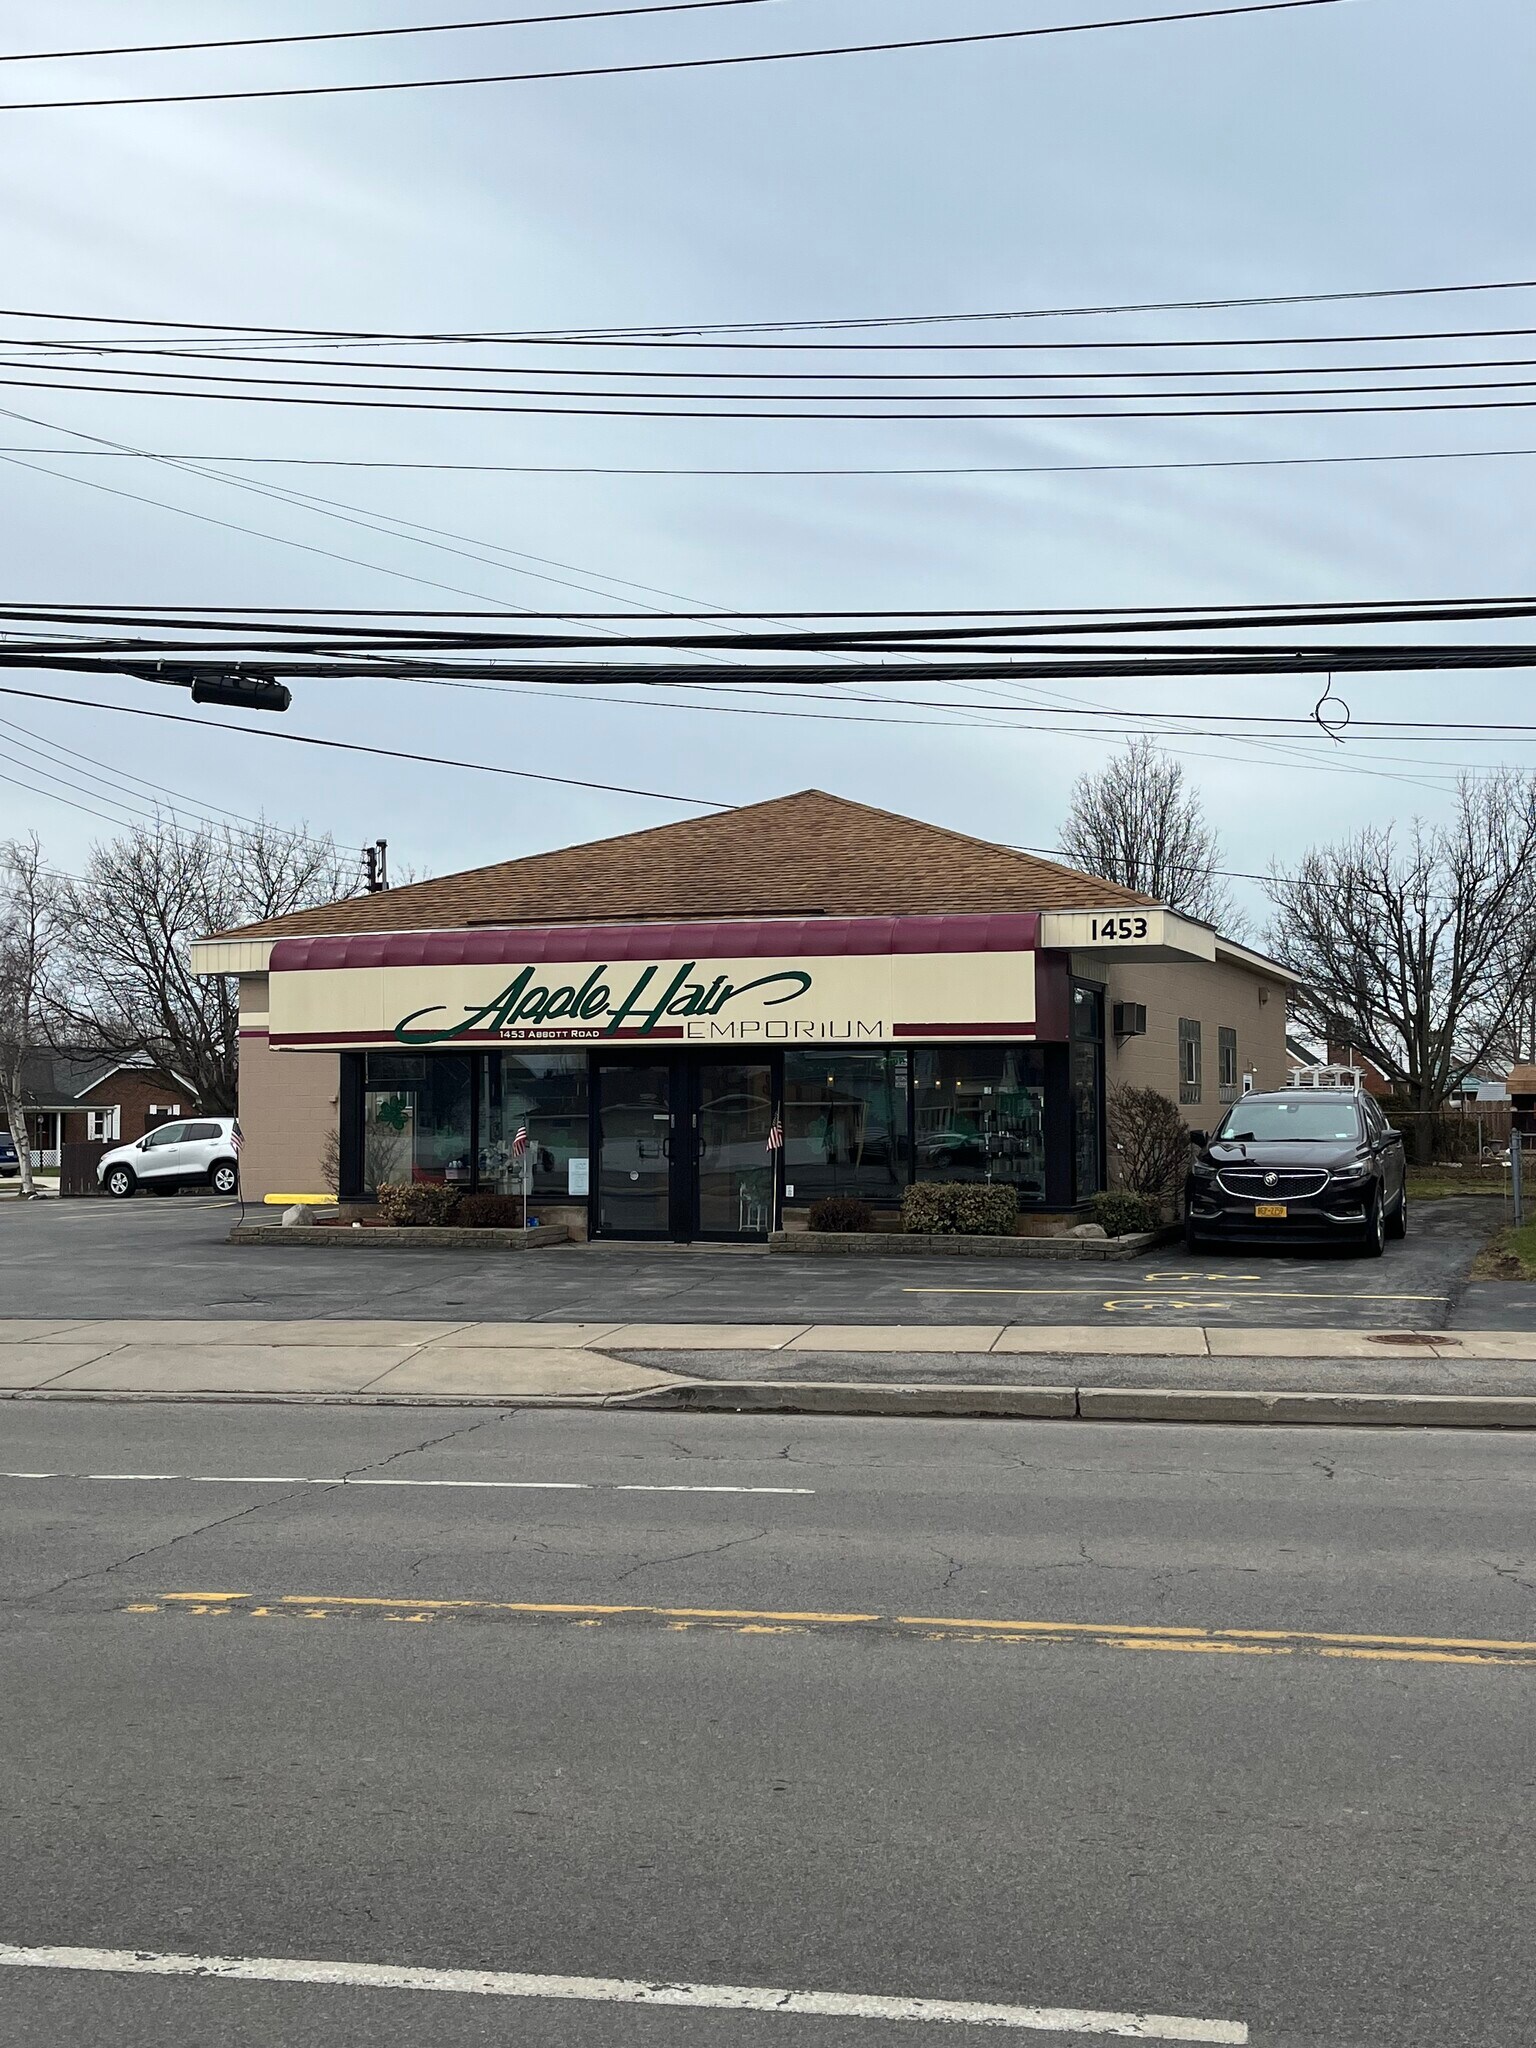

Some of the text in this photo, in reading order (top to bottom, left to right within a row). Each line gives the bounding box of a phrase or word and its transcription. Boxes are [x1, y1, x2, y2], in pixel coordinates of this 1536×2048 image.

[1092, 917, 1147, 940] 1453
[394, 961, 811, 1043] Apple Hair
[500, 1030, 600, 1039] 1453 ABBOTT ROAD
[688, 1020, 883, 1039] EMPORIUM
